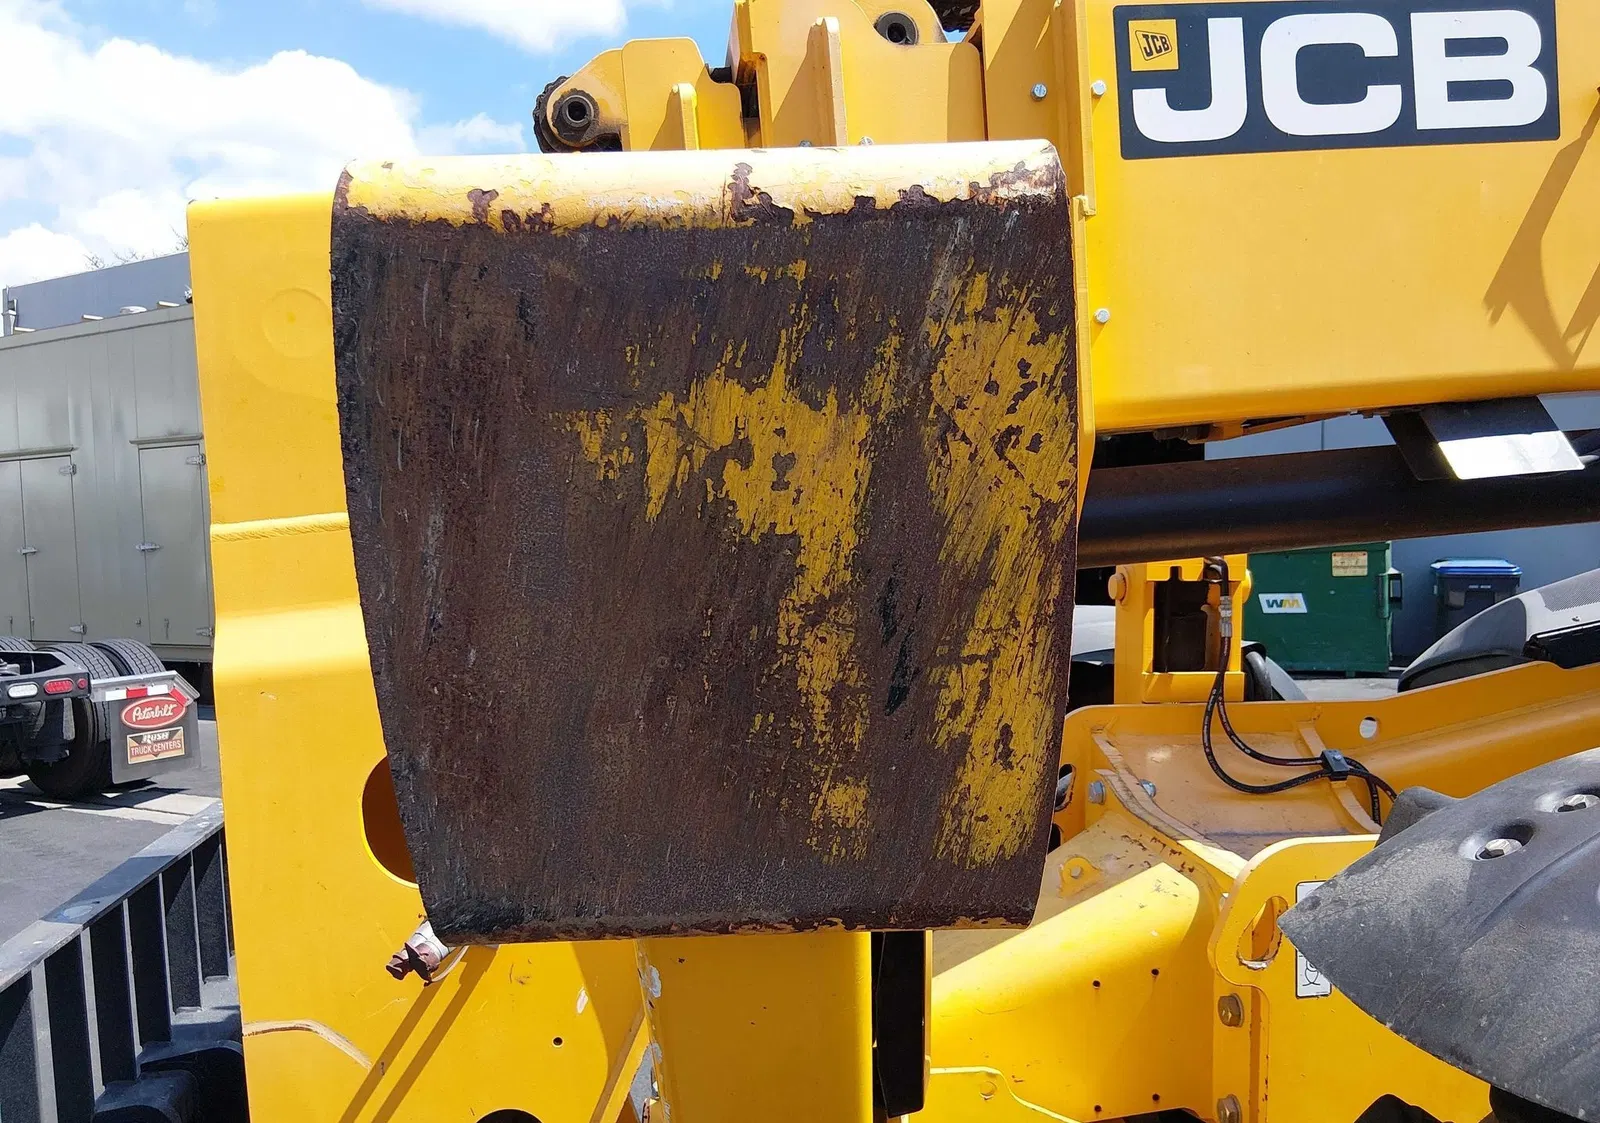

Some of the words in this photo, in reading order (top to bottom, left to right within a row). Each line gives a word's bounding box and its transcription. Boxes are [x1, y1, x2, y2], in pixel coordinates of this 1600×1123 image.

[1141, 33, 1170, 57] JCB
[1132, 10, 1547, 143] JCB
[1265, 599, 1302, 608] WM
[132, 704, 177, 722] Peterbilt
[131, 746, 151, 756] TRUCK
[153, 740, 181, 752] CENTERS
